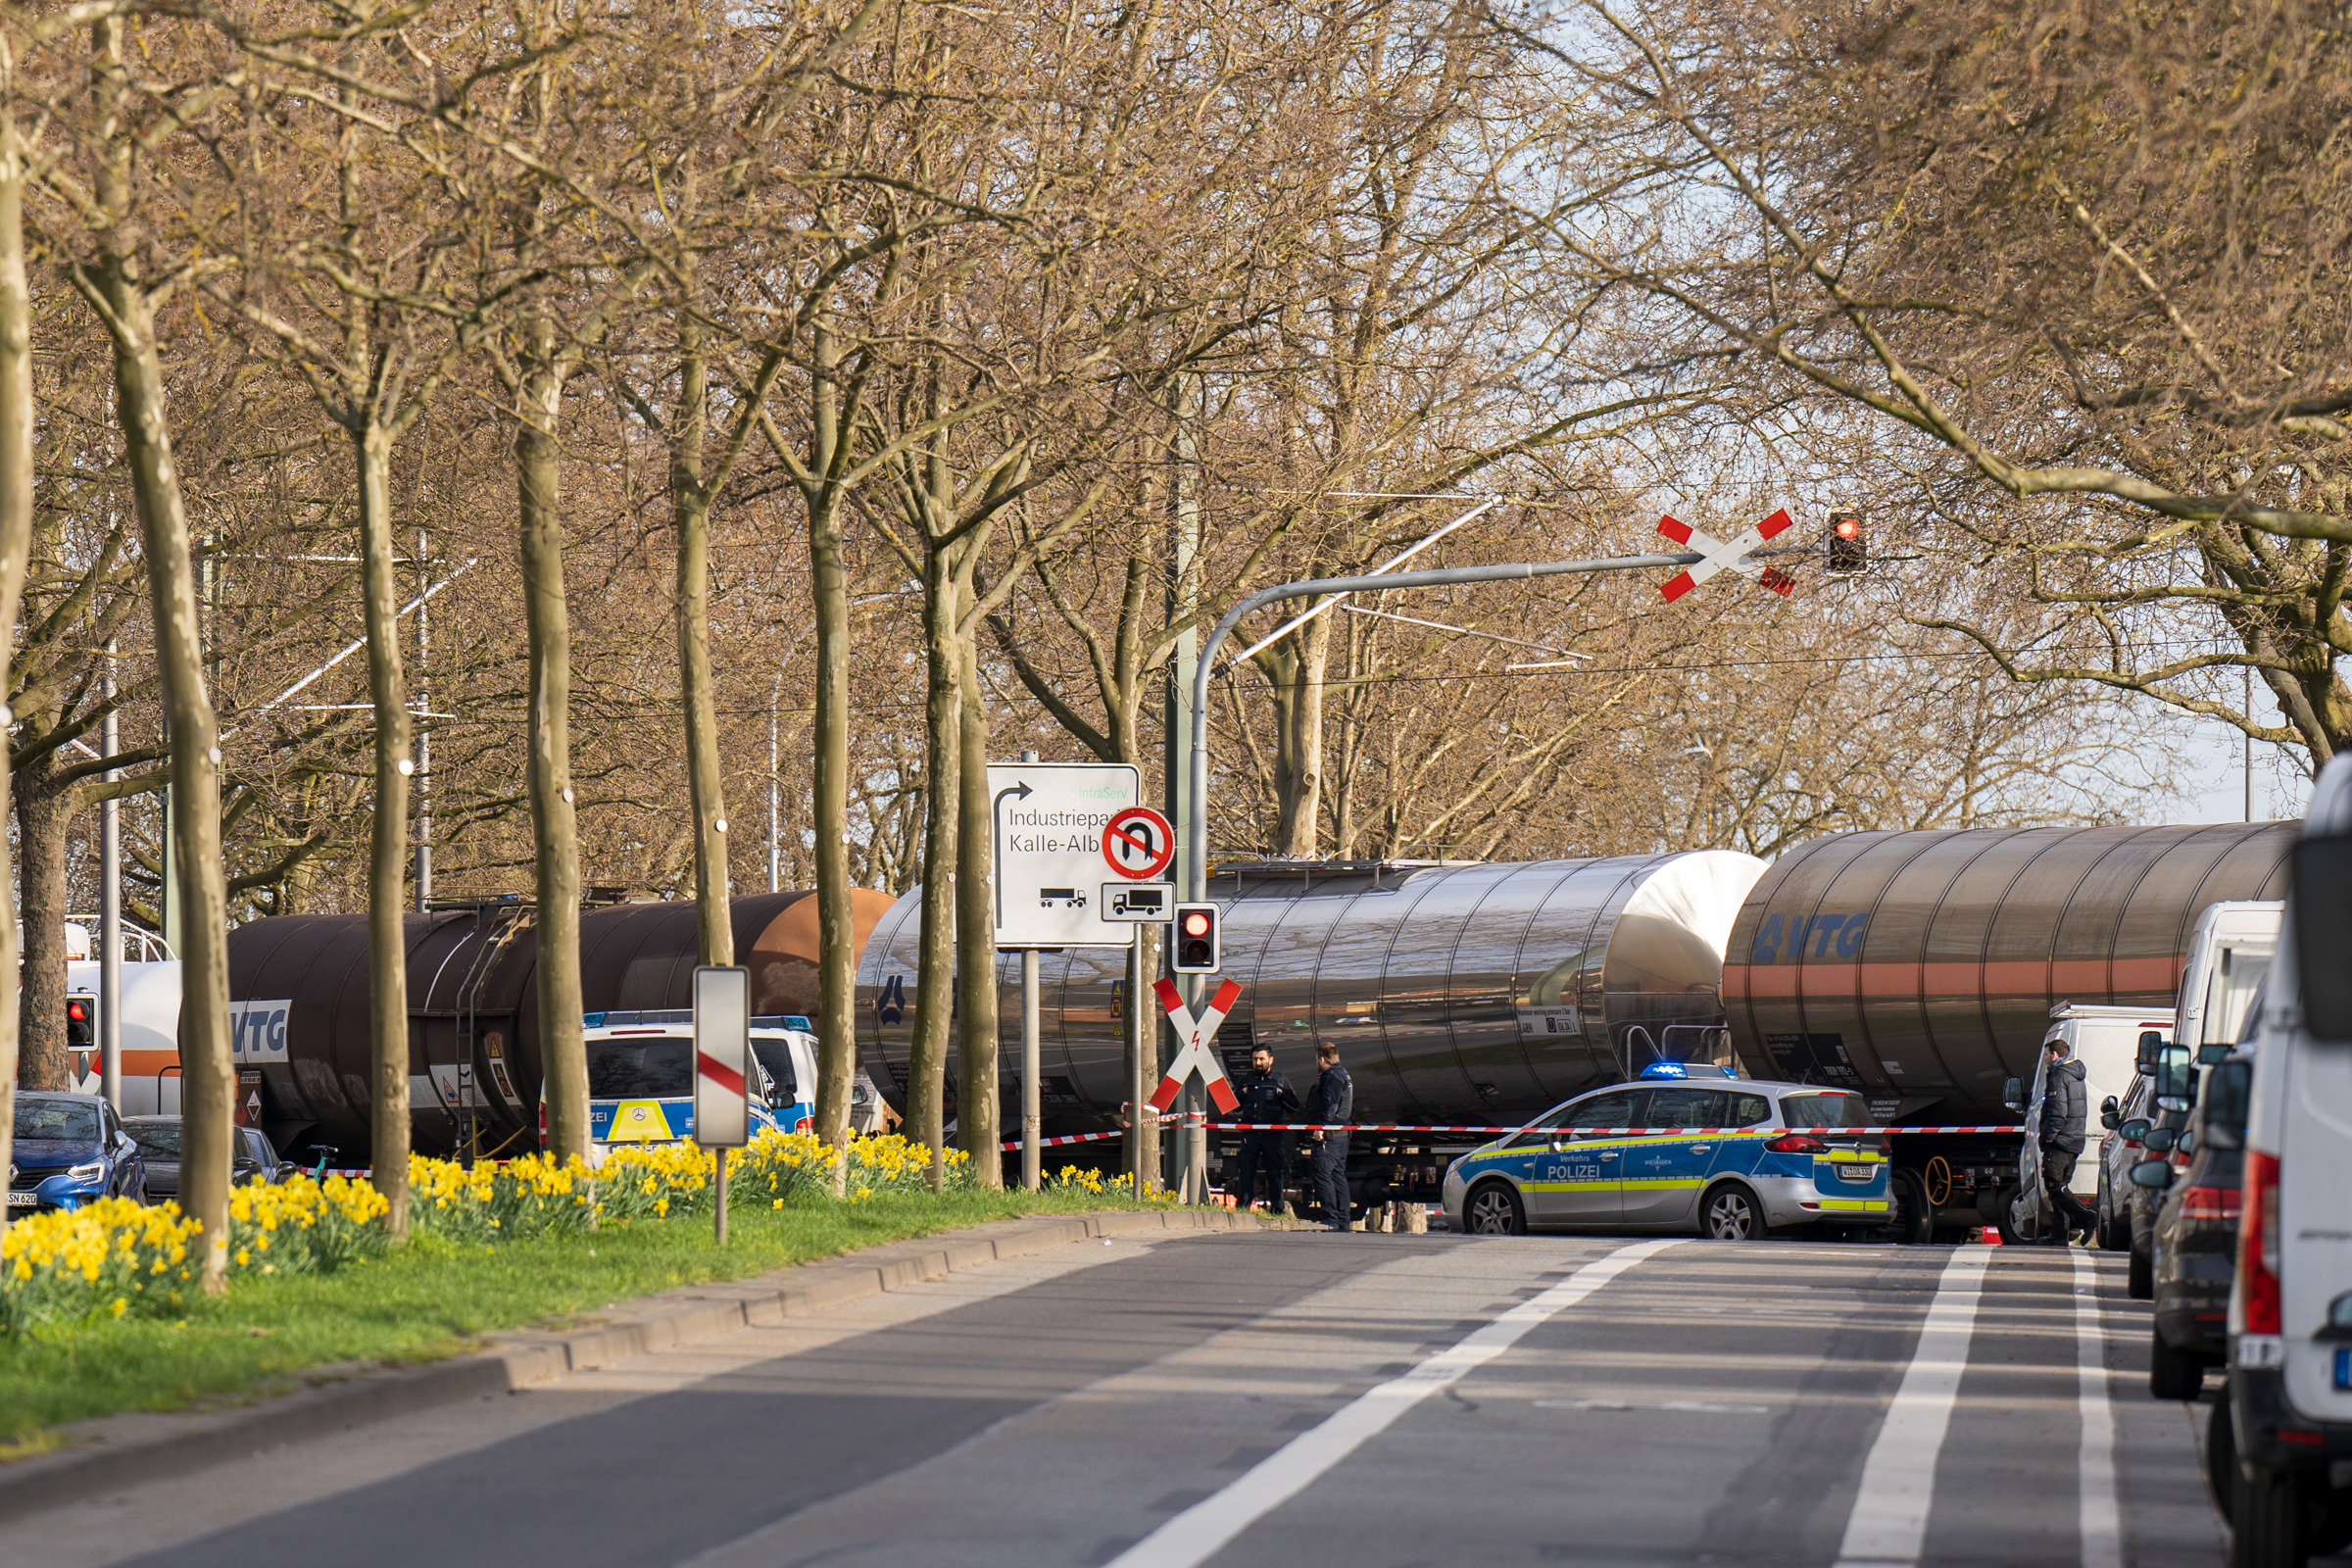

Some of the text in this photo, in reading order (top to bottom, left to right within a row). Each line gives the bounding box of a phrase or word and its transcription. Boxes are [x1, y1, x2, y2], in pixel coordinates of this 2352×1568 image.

[1009, 808, 1117, 830] Industriepa
[1788, 911, 1869, 958] VTG
[230, 1008, 286, 1054] VTG
[1560, 1154, 1591, 1163] Verkehrs
[1547, 1164, 1600, 1180] POLIZEI
[8, 1193, 36, 1203] SN 620
